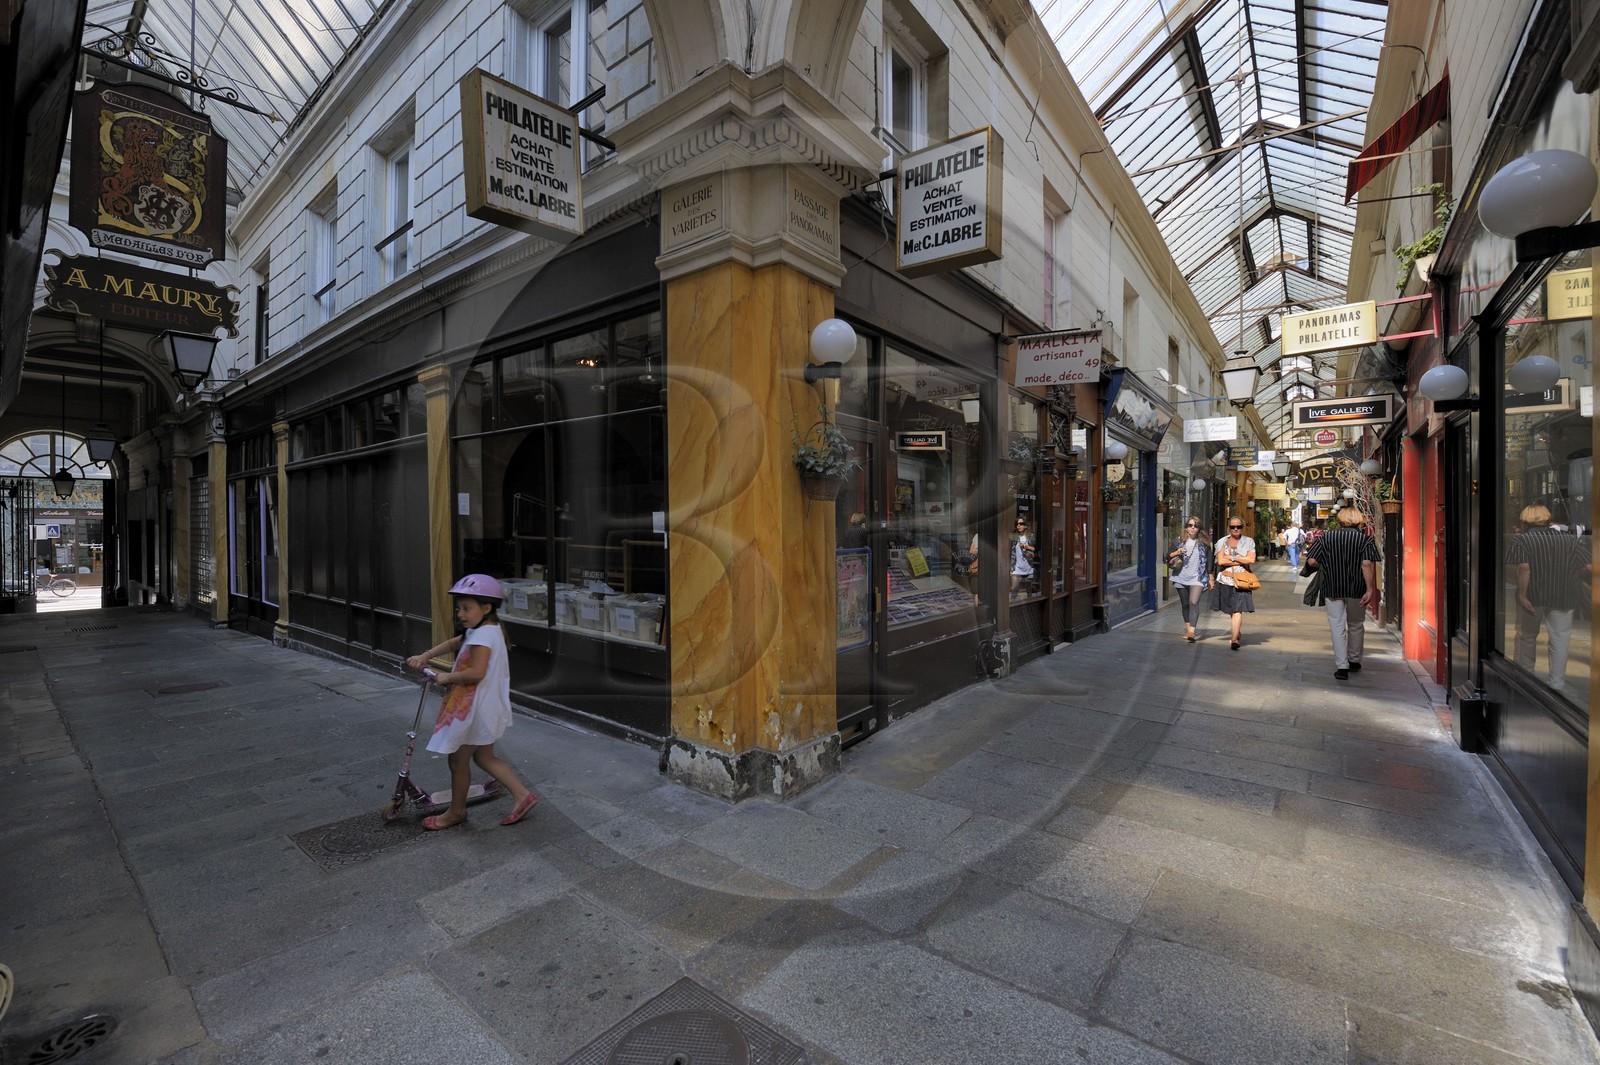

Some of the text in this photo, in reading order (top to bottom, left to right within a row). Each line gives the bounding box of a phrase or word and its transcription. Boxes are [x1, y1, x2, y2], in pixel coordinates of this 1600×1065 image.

[510, 133, 553, 160] ACHAT
[510, 148, 555, 175] VENTE
[495, 157, 568, 194] ESTIMATION
[672, 184, 713, 214] GALERIE
[922, 180, 963, 202] ACHAT
[687, 205, 701, 217] DES
[793, 188, 829, 221] PASSAGE
[923, 194, 963, 215] VENTE
[805, 210, 818, 223] DES
[909, 204, 976, 232] ESTIMATION
[789, 211, 834, 246] PANORAMAS
[1298, 310, 1362, 330] PANORAMAS
[1018, 332, 1100, 351] MAALKITA
[1298, 326, 1360, 345] PHILATELIE
[1032, 348, 1084, 363] artisanat
[1084, 358, 1100, 369] 49
[1330, 405, 1375, 416] GALLERY
